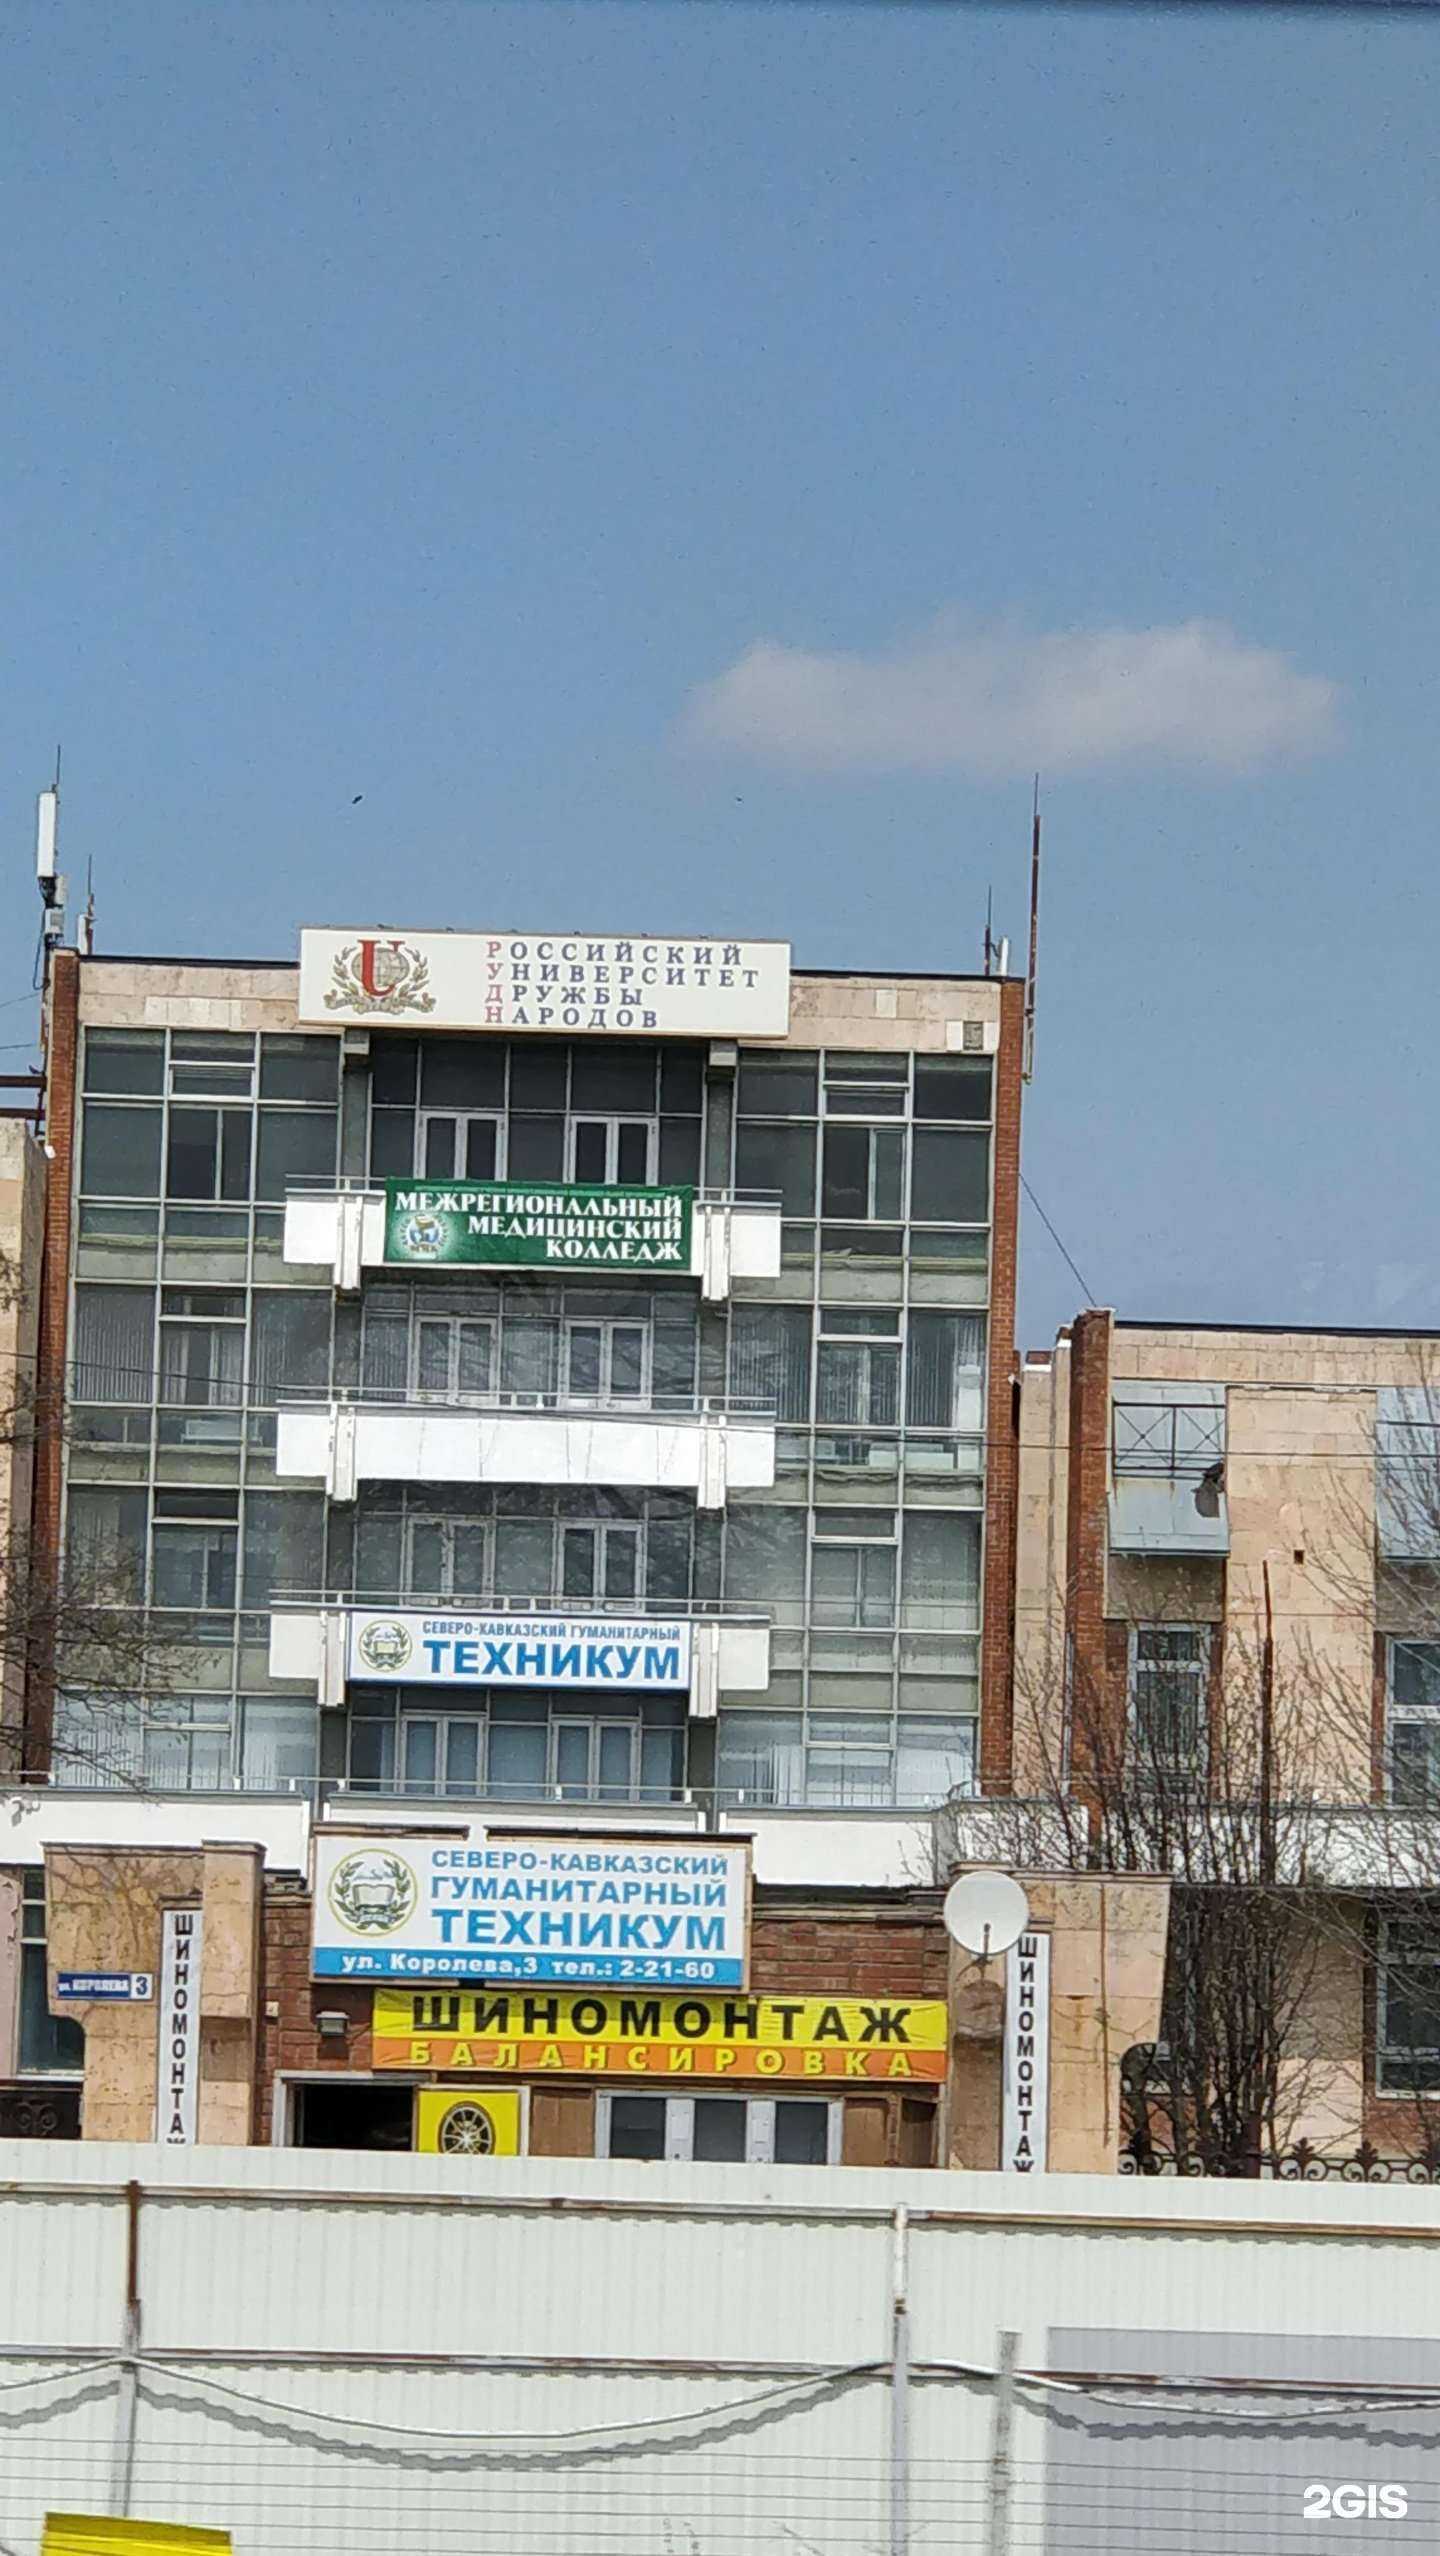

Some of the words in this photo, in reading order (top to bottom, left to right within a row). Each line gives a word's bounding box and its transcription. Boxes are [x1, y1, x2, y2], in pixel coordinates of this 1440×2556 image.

[486, 940, 743, 966] РОССИЙСКИЙ
[486, 963, 759, 988] УНИВЕРСИТЕТ
[485, 984, 643, 1006] ДРУЖБЫ
[485, 1006, 657, 1029] НАРОДОВ
[394, 1192, 682, 1218] МЕЖРЕГИОНАЛЬНЫЙ
[468, 1215, 682, 1240] МЕДИЦИНСКИЙ
[546, 1239, 682, 1263] КОЛЛЕДЖ
[423, 1620, 567, 1638] СЕВЕРО-КАВКАЗСКИЙ
[570, 1624, 681, 1641] ГУМАНИТАРНЫЙ
[422, 1640, 680, 1680] ТЕХНИКУМ
[431, 1850, 729, 1876] СЕВЕРО-КАВКАЗСКИЙ
[431, 1876, 728, 1908] ГУМАНИТАРНЫЙ
[431, 1908, 727, 1951] ТЕХНИКУМ
[341, 1955, 382, 1973] ул.
[551, 1961, 613, 1977] тел.:
[620, 1959, 716, 1980] 2-21-60
[136, 1976, 148, 1996] 3
[167, 1914, 194, 2144] ШИНОМОНТА
[412, 1996, 912, 2043] ШИНОМОНТАЖ
[410, 2041, 912, 2077] БАЛАНСИРОВКА
